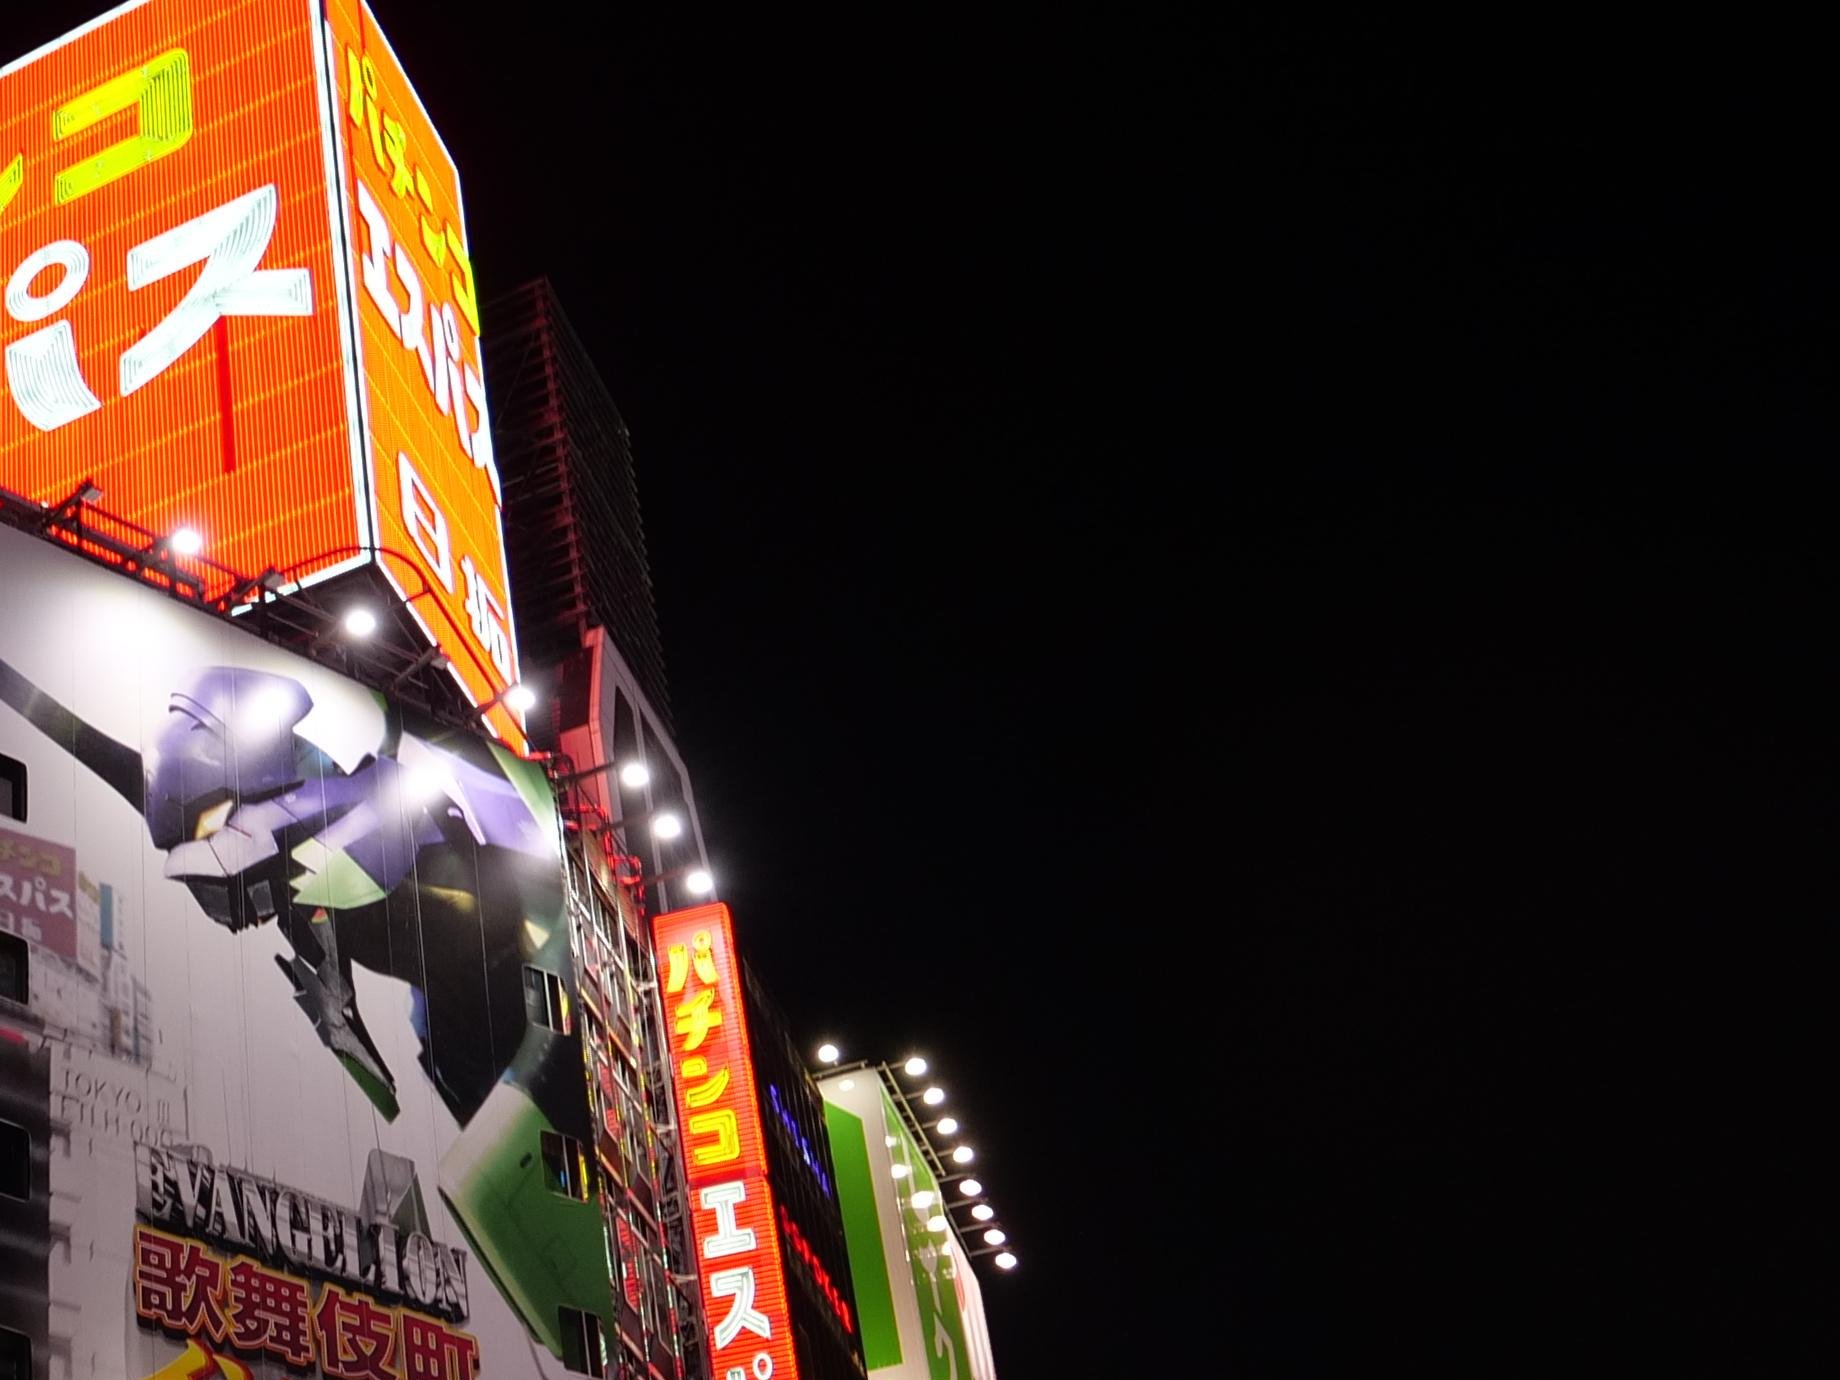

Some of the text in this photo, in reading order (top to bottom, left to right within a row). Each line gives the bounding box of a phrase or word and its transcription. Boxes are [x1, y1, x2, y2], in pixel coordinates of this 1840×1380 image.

[346, 42, 480, 337] パチンコ
[358, 180, 498, 480] エスパス
[398, 450, 510, 685] 日拓
[667, 930, 742, 1168] パチンコ
[143, 1145, 467, 1322] EVANGELION
